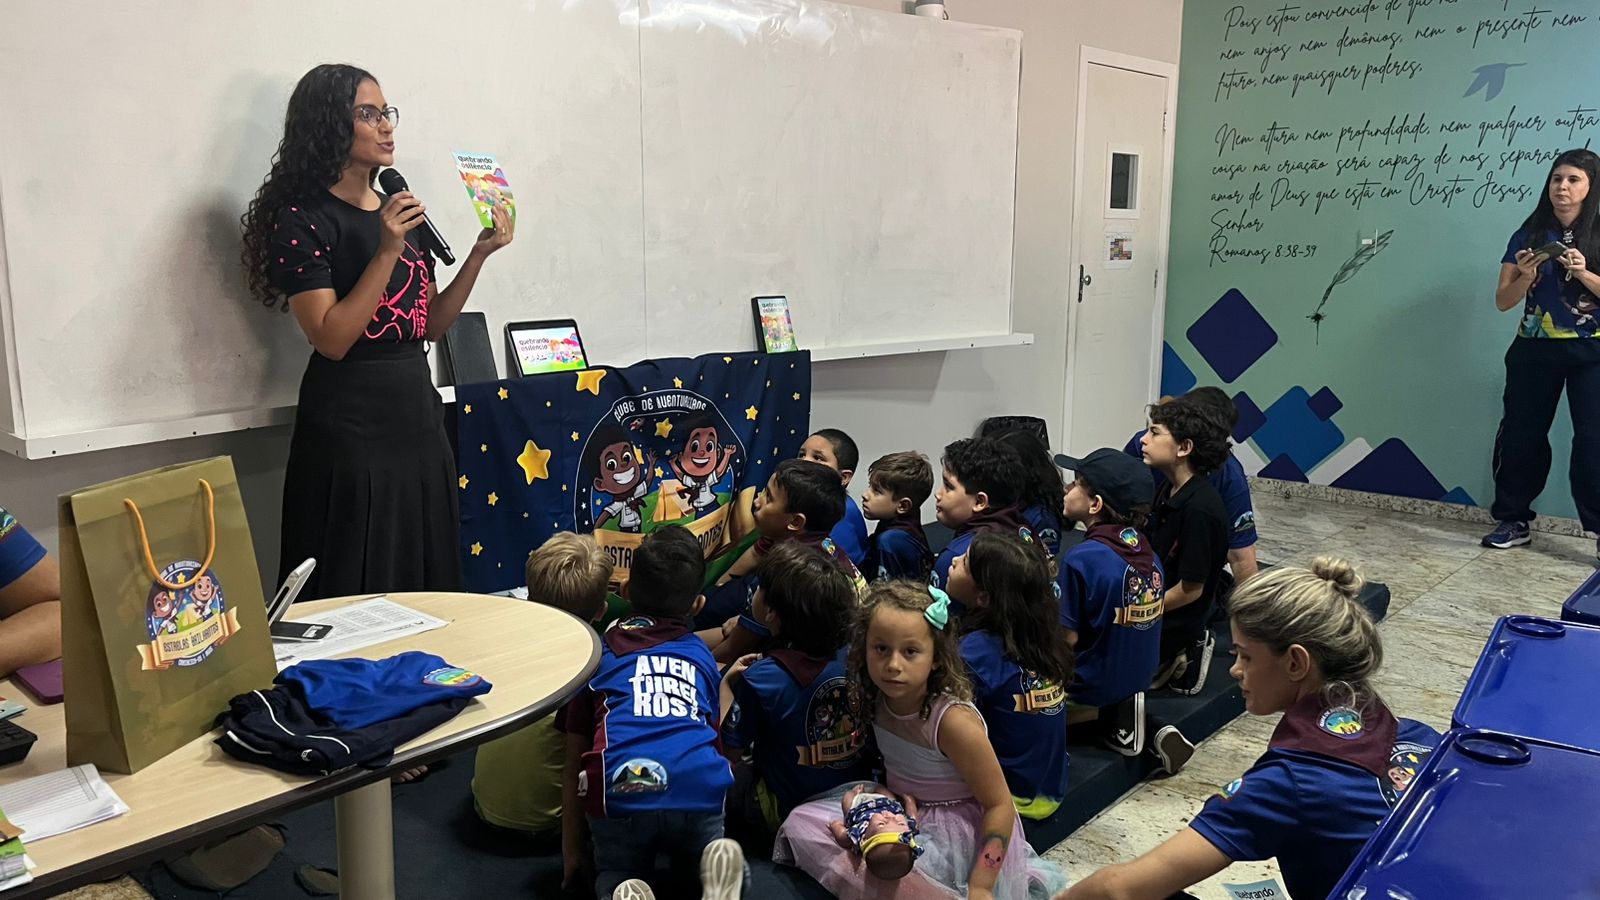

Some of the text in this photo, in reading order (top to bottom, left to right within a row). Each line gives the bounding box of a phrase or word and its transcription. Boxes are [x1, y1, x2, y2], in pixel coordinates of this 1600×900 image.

[1224, 5, 1262, 41] Pois
[1266, 3, 1301, 36] estou
[1305, 0, 1379, 22] convencido
[1219, 49, 1245, 60] nem
[1253, 43, 1291, 73] anjos
[1299, 41, 1327, 52] nem
[1415, 26, 1446, 39] nem
[1456, 26, 1467, 34] o
[1472, 6, 1552, 49] presente
[1551, 14, 1587, 27] nem
[1262, 74, 1289, 87] nem
[1292, 65, 1362, 98] quaisquer
[1214, 123, 1253, 156] Nem
[1260, 121, 1299, 155] altura
[1305, 128, 1332, 141] nem
[1439, 120, 1471, 132] nem
[1478, 105, 1546, 148] qualquer
[1555, 104, 1599, 140] outra
[1212, 164, 1247, 180] coisa
[1253, 163, 1270, 172] na
[1277, 159, 1328, 174] criação
[1336, 156, 1372, 176] será
[1378, 154, 1426, 180] capaz
[1434, 143, 1452, 174] de
[1459, 152, 1490, 171] nos
[1210, 191, 1244, 203] amor
[1249, 182, 1263, 209] de
[1270, 177, 1311, 211] Deus
[1316, 189, 1340, 215] que
[1345, 178, 1382, 210] está
[1380, 186, 1402, 199] em
[1409, 172, 1474, 208] Cristo
[1210, 208, 1264, 240] Senhor
[1209, 235, 1271, 267] Romanos
[641, 398, 654, 411] DE
[634, 655, 696, 685] AVEN
[633, 692, 688, 718] ROS
